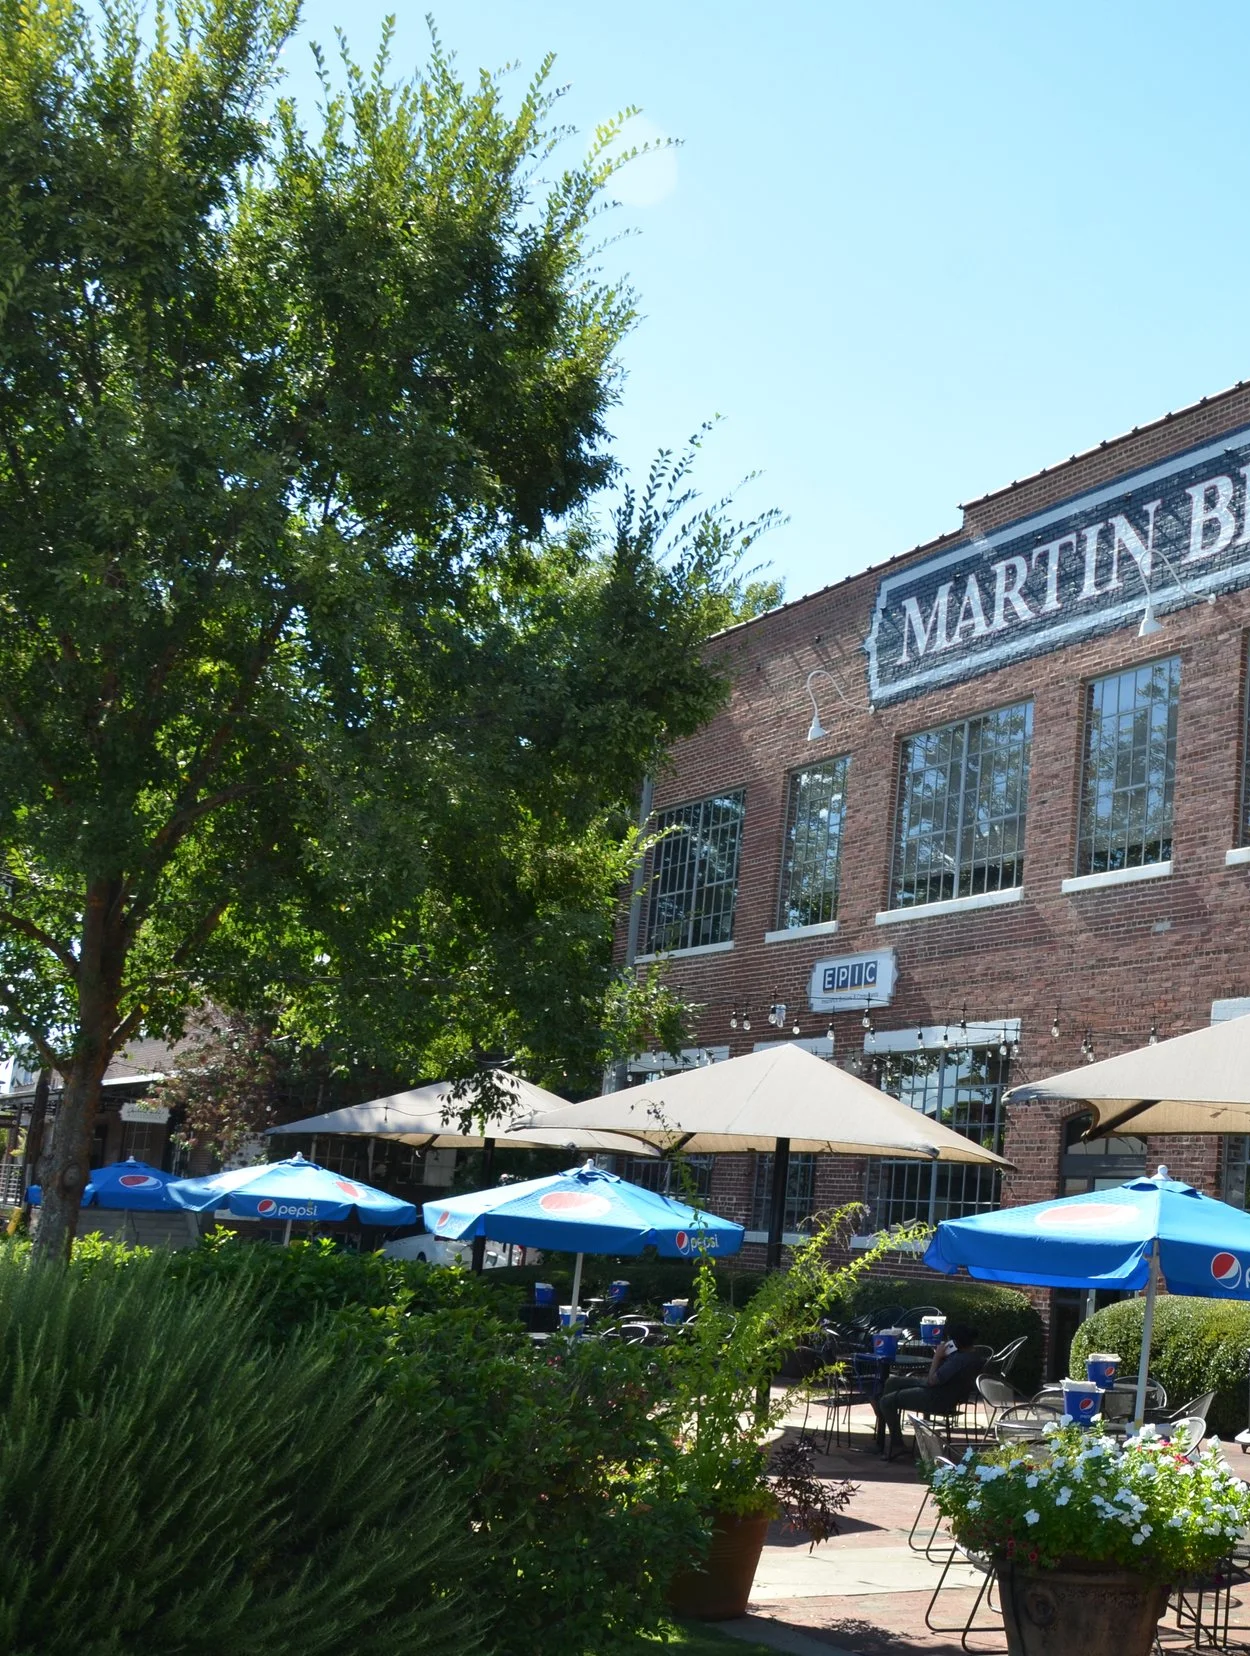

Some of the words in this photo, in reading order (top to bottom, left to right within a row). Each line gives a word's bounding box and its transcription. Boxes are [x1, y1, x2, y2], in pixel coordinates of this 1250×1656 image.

[897, 499, 1162, 664] MARTIN
[824, 962, 877, 989] EPIC
[278, 1205, 318, 1217] pepsi
